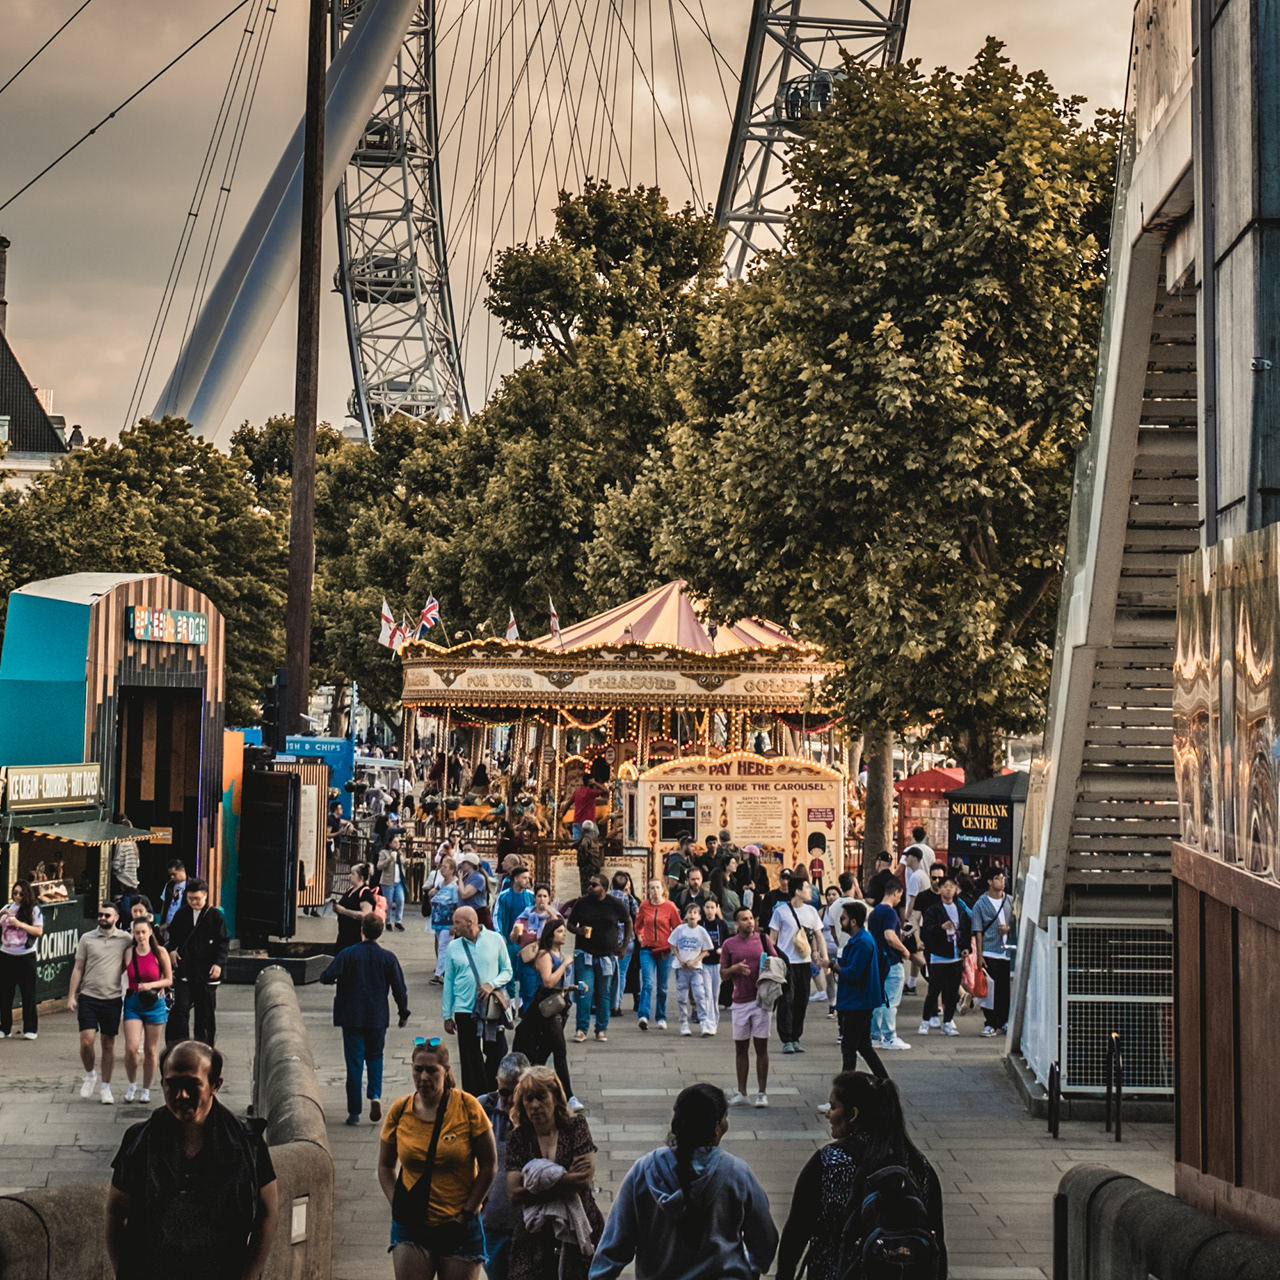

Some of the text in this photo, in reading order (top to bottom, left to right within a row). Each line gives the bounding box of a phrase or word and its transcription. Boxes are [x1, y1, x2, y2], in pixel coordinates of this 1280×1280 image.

[467, 673, 533, 688] FOR YOUR
[588, 674, 677, 691] PLEASURE
[708, 761, 773, 776] PAY HERE
[9, 771, 98, 800] ICE CREAM CHURROS HOT DOGS
[658, 783, 826, 791] PAY HERE TO RIDE THE CAROUSEL
[952, 803, 1008, 817] SOUTHBANK
[962, 816, 998, 830] CENTRE
